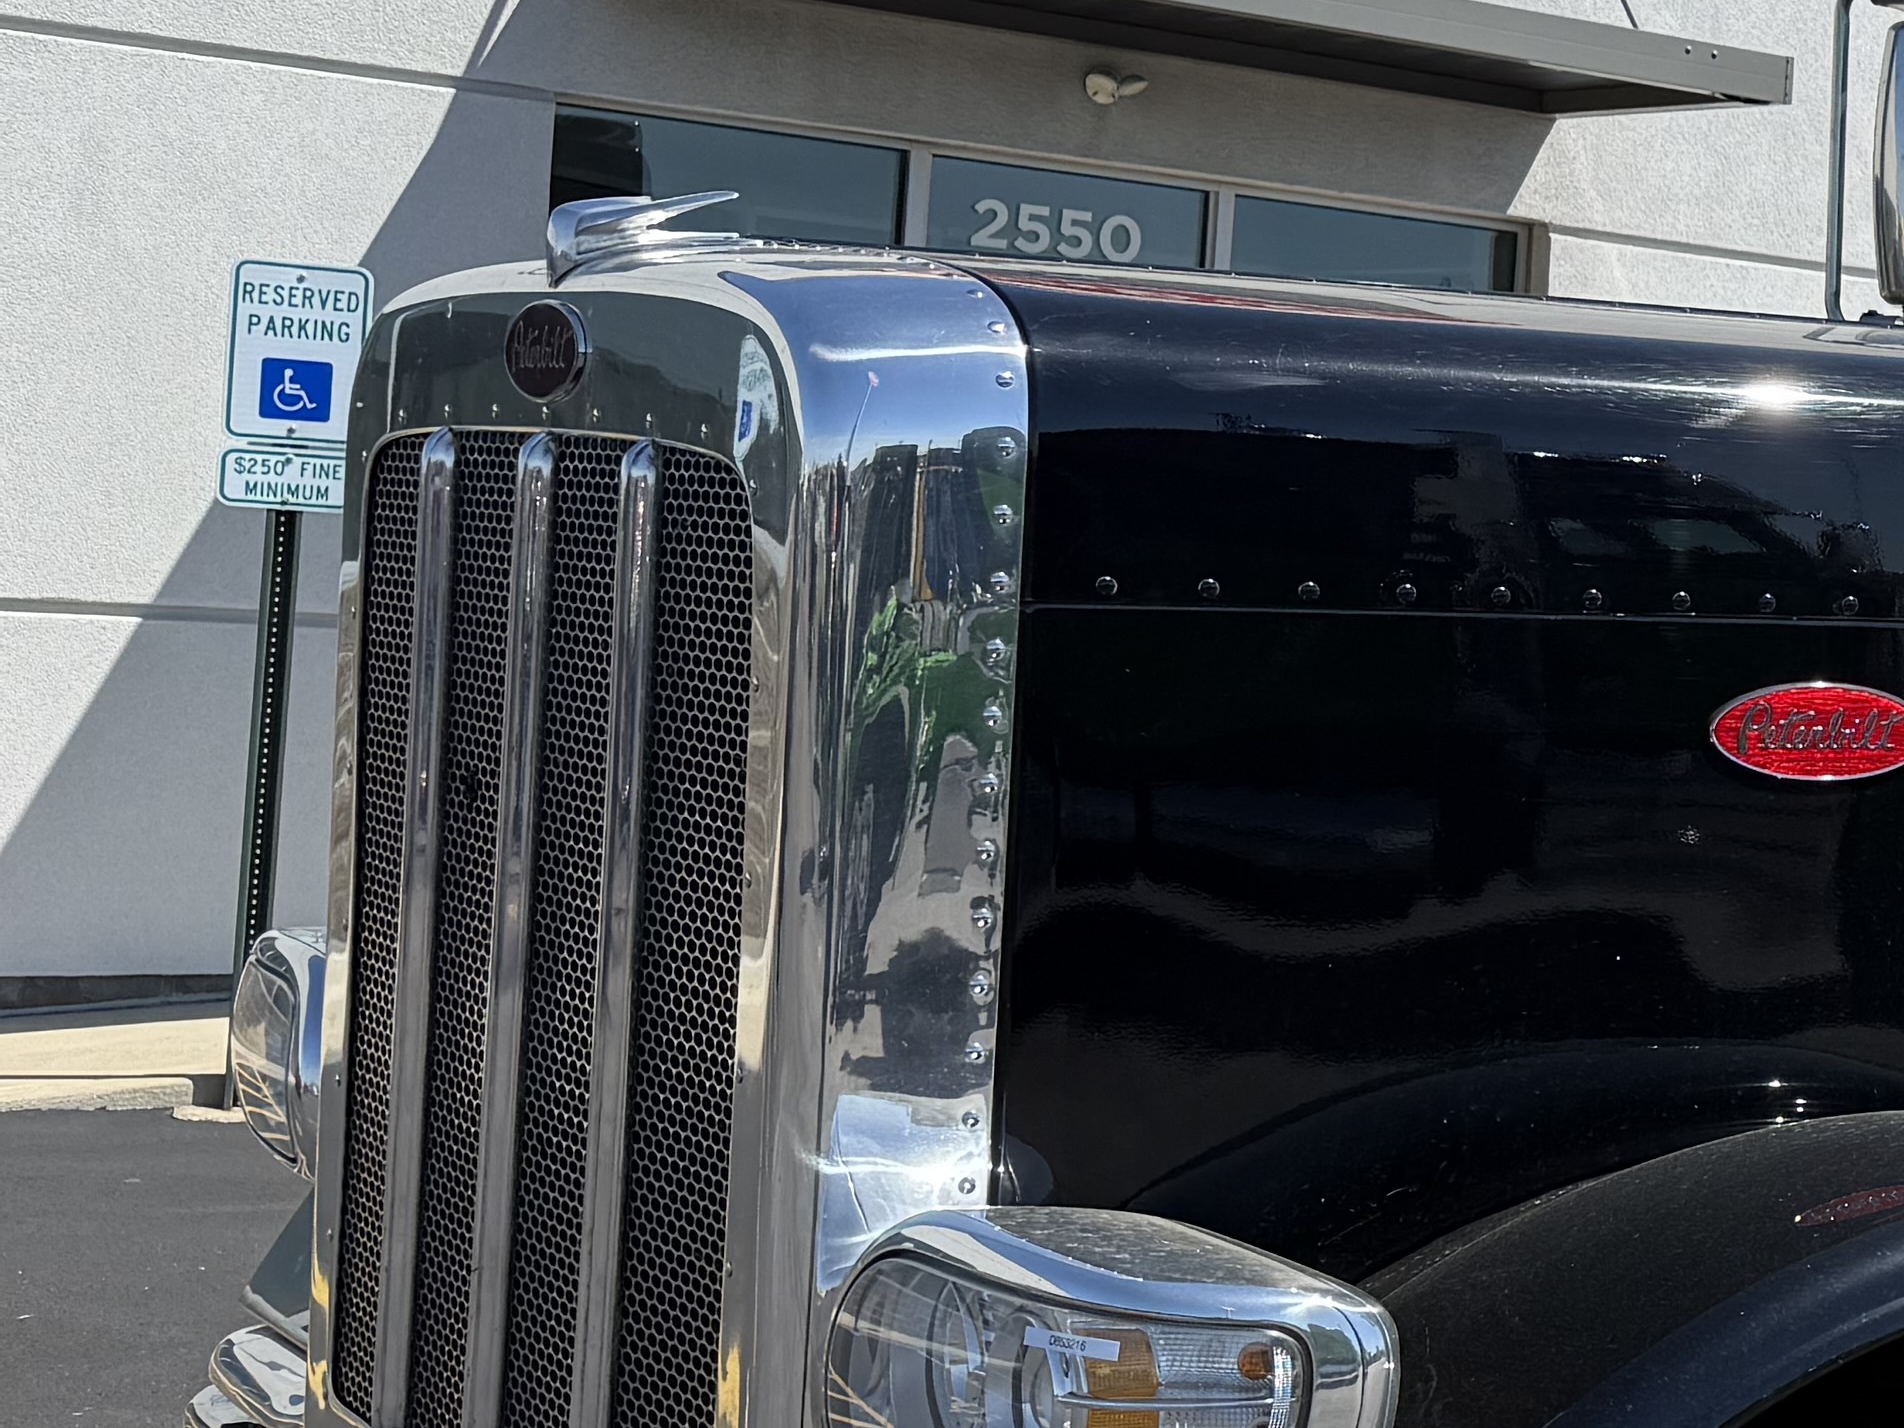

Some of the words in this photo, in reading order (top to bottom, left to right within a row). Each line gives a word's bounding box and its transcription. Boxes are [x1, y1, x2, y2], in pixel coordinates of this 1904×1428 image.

[970, 199, 1142, 263] 2550
[241, 281, 360, 313] RESERVED
[247, 314, 351, 344] PARKING
[233, 456, 285, 476] $250
[300, 462, 343, 481] FINE
[244, 480, 330, 502] MINIMUM
